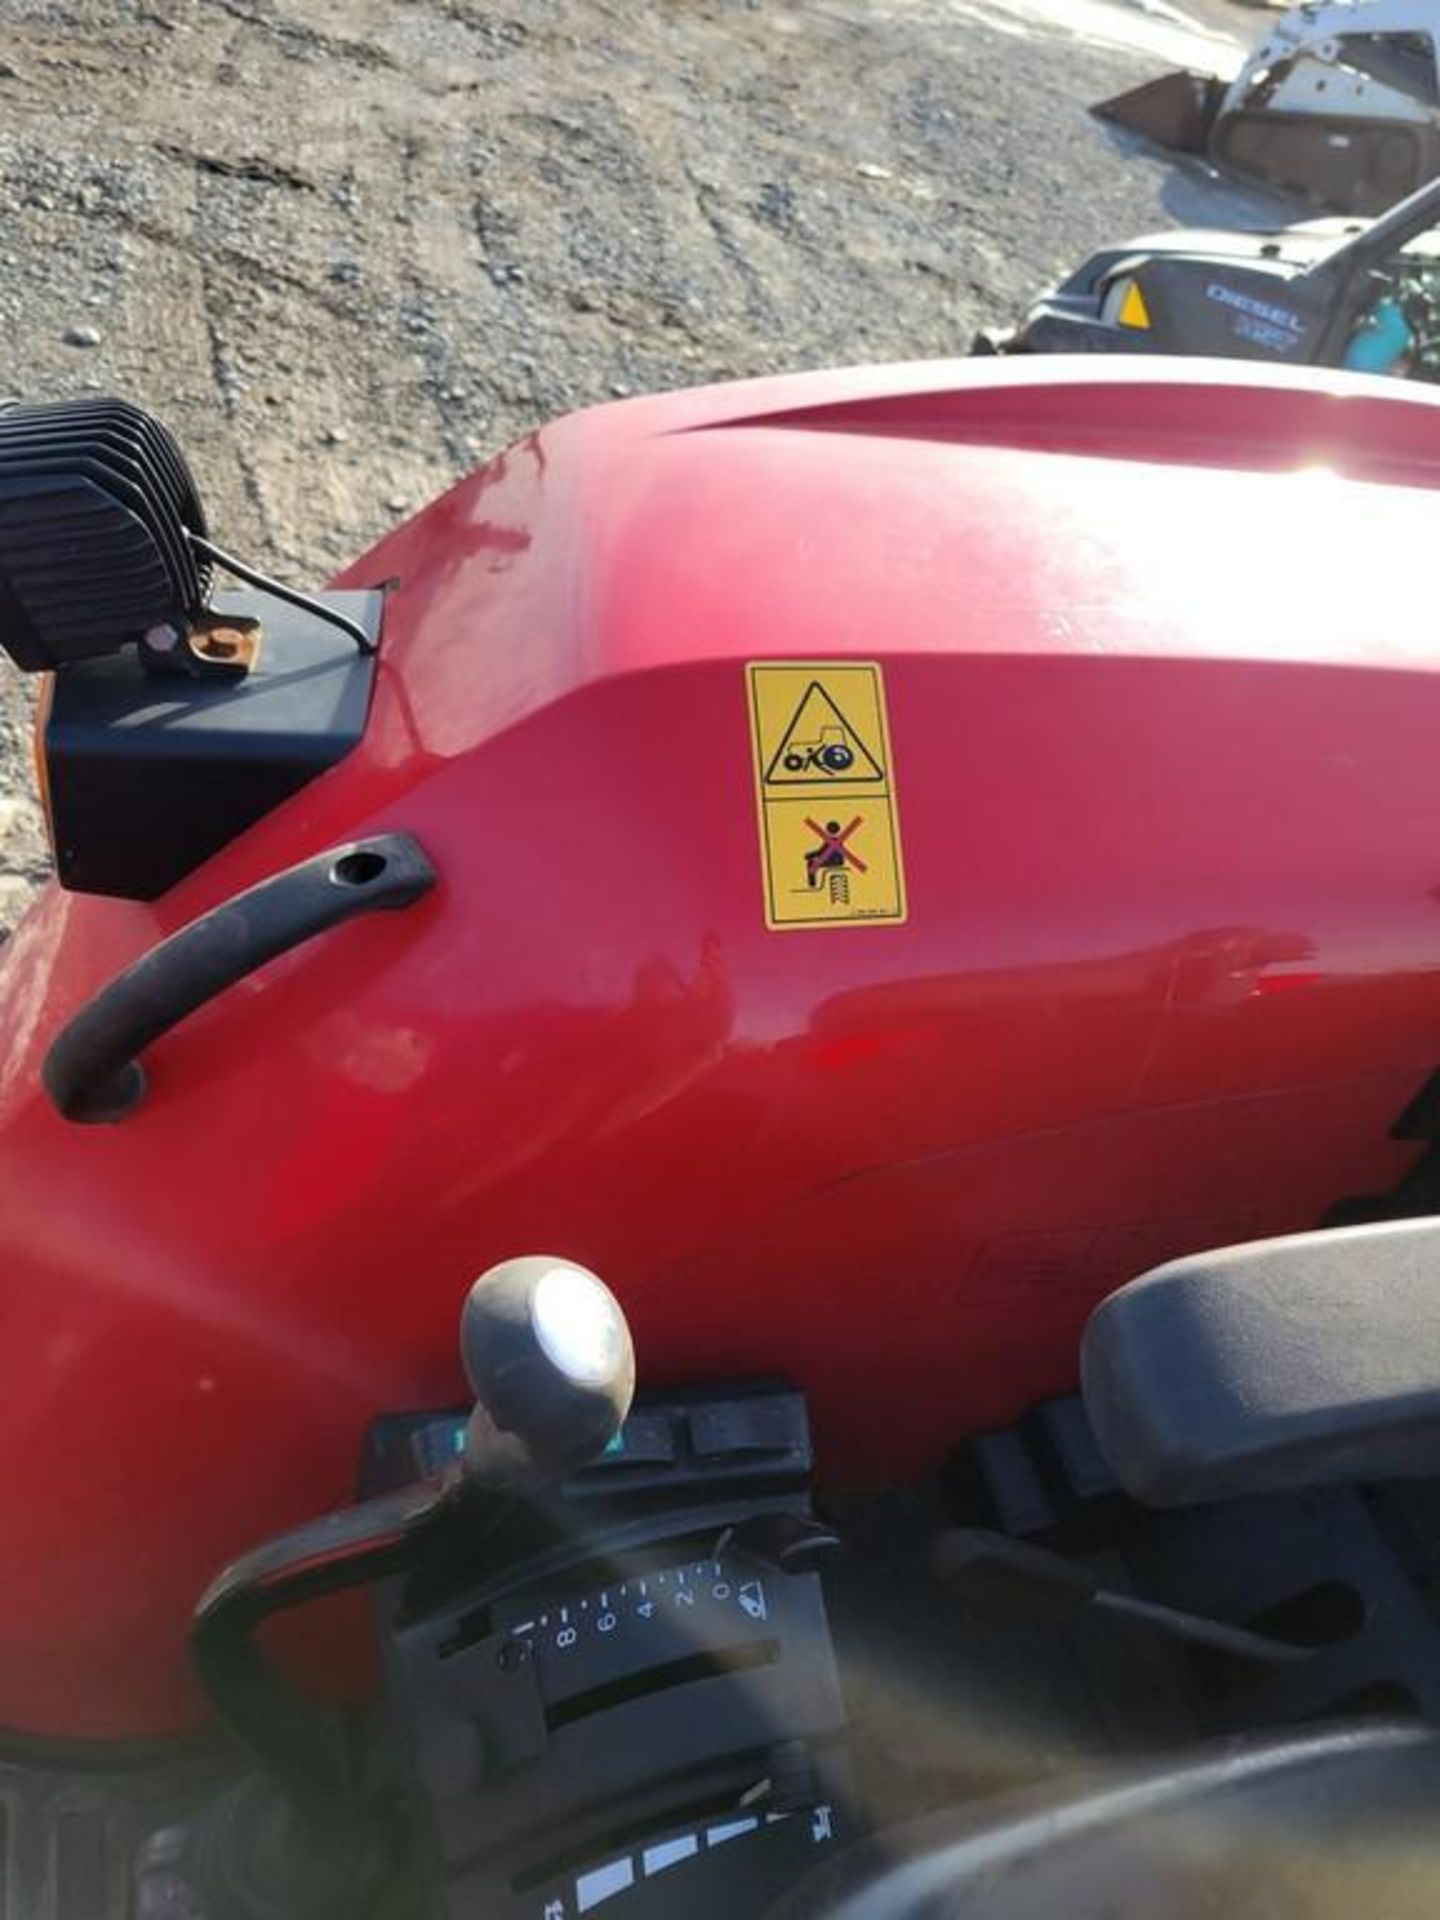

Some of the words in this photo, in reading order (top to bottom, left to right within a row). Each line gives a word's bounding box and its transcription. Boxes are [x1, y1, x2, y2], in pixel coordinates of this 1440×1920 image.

[676, 1590, 694, 1606] 2
[712, 1583, 731, 1599] 0
[637, 1602, 654, 1618] 4
[597, 1612, 616, 1632] 6
[556, 1627, 577, 1648] 8
